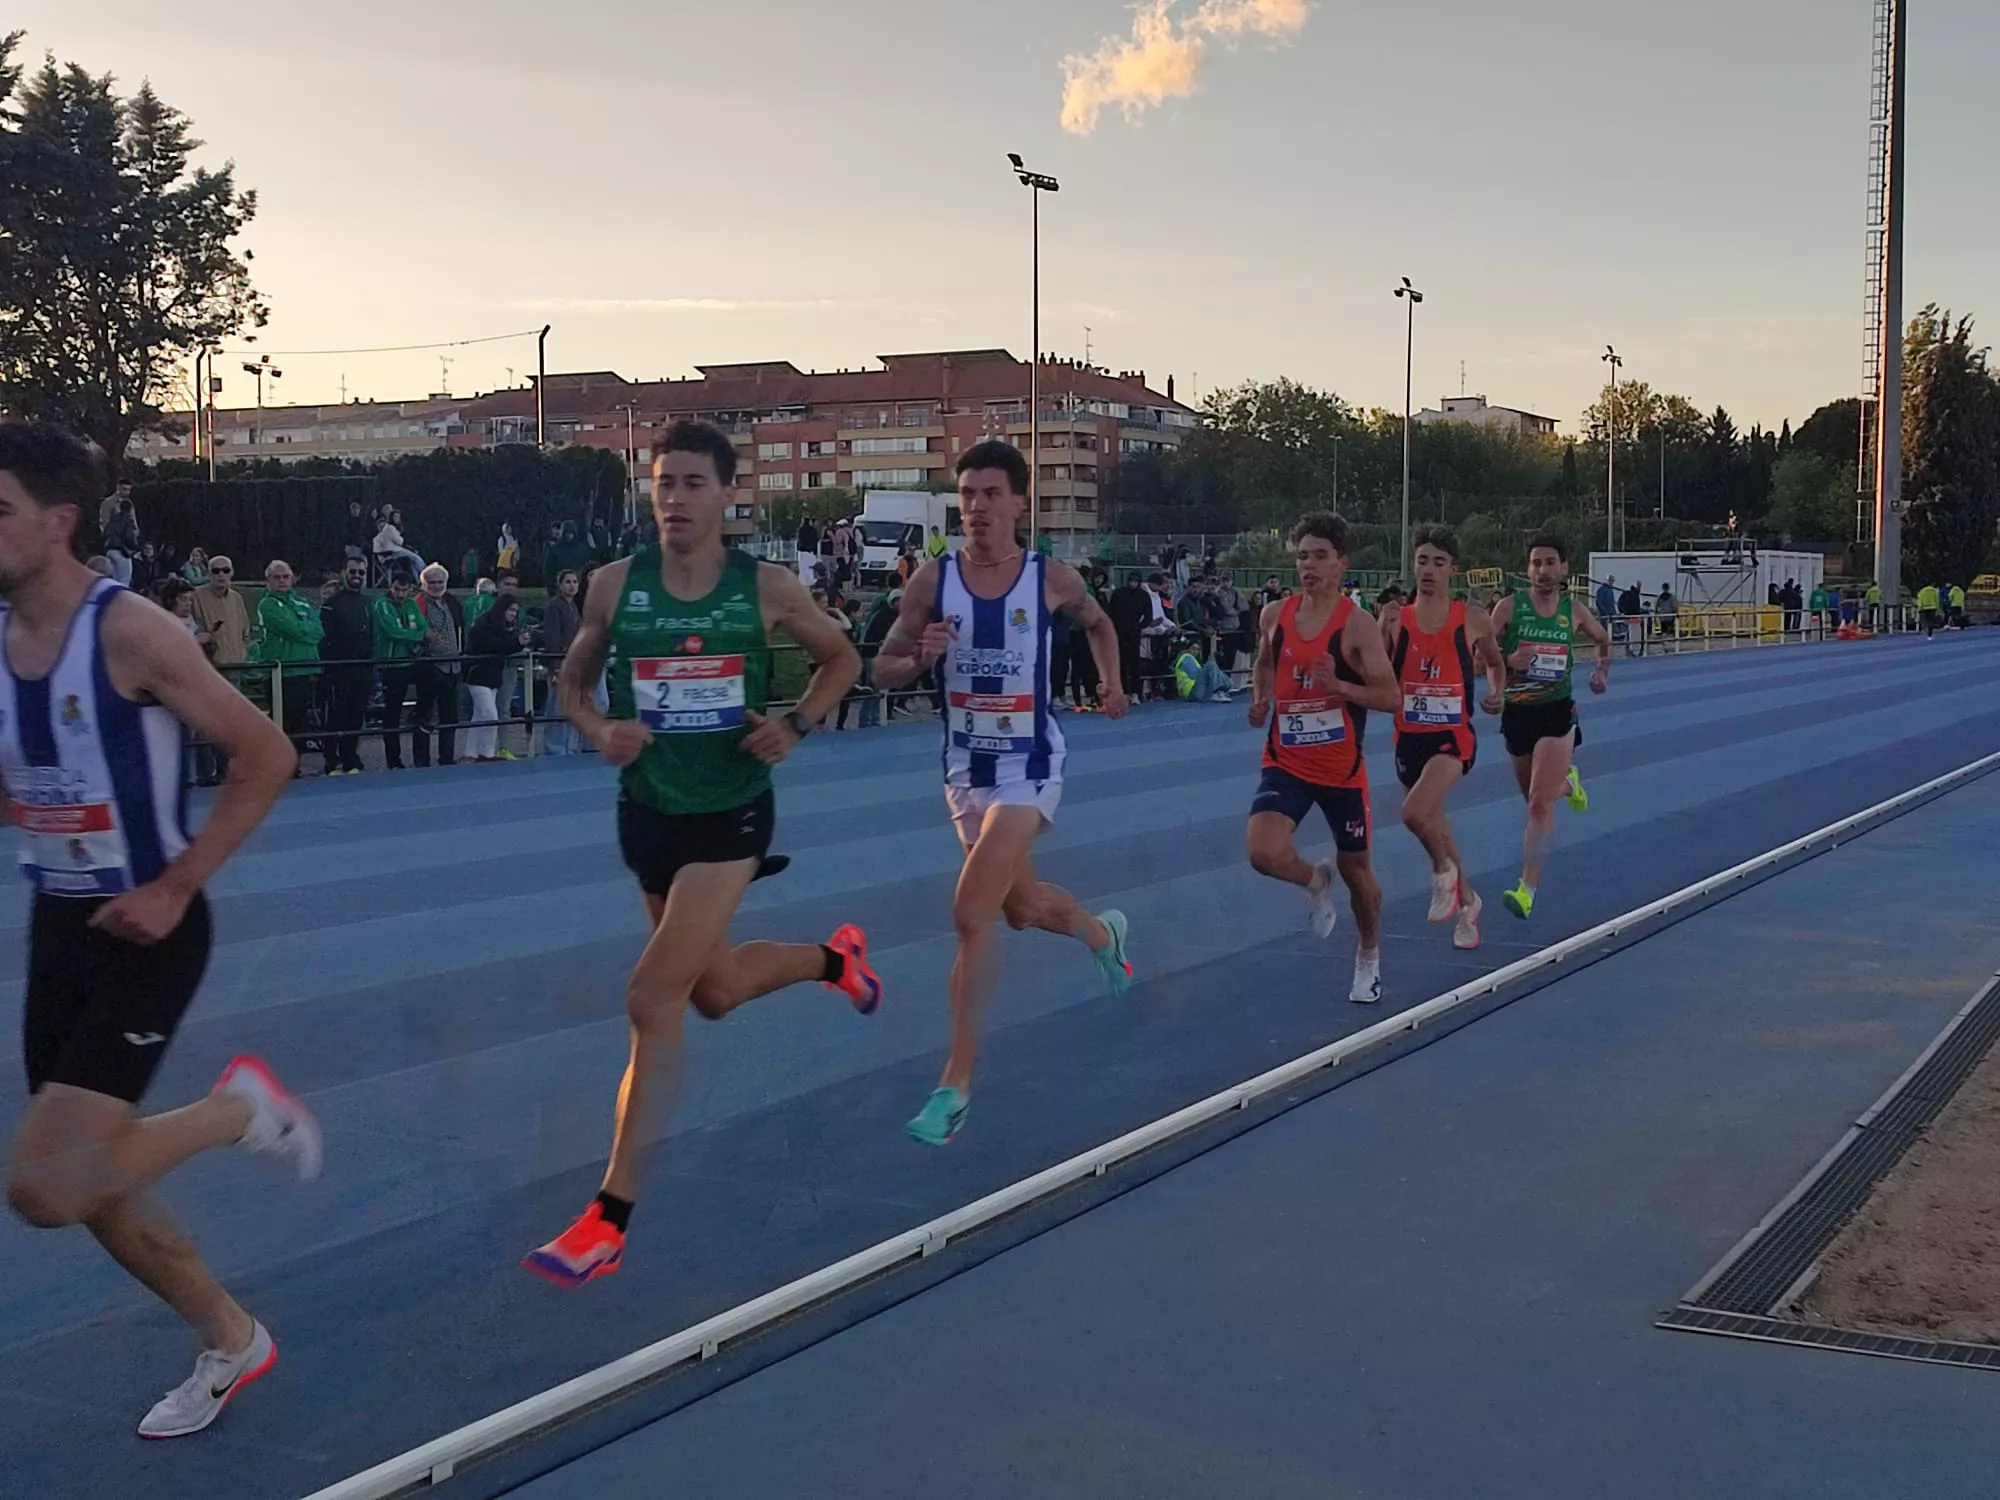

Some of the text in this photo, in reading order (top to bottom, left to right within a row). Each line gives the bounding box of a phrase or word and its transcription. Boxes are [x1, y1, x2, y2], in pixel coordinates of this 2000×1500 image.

[1517, 624, 1568, 640] Huesca
[656, 681, 670, 709] 2
[1412, 696, 1428, 712] 26
[965, 711, 974, 733] 8
[1287, 715, 1305, 732] 25
